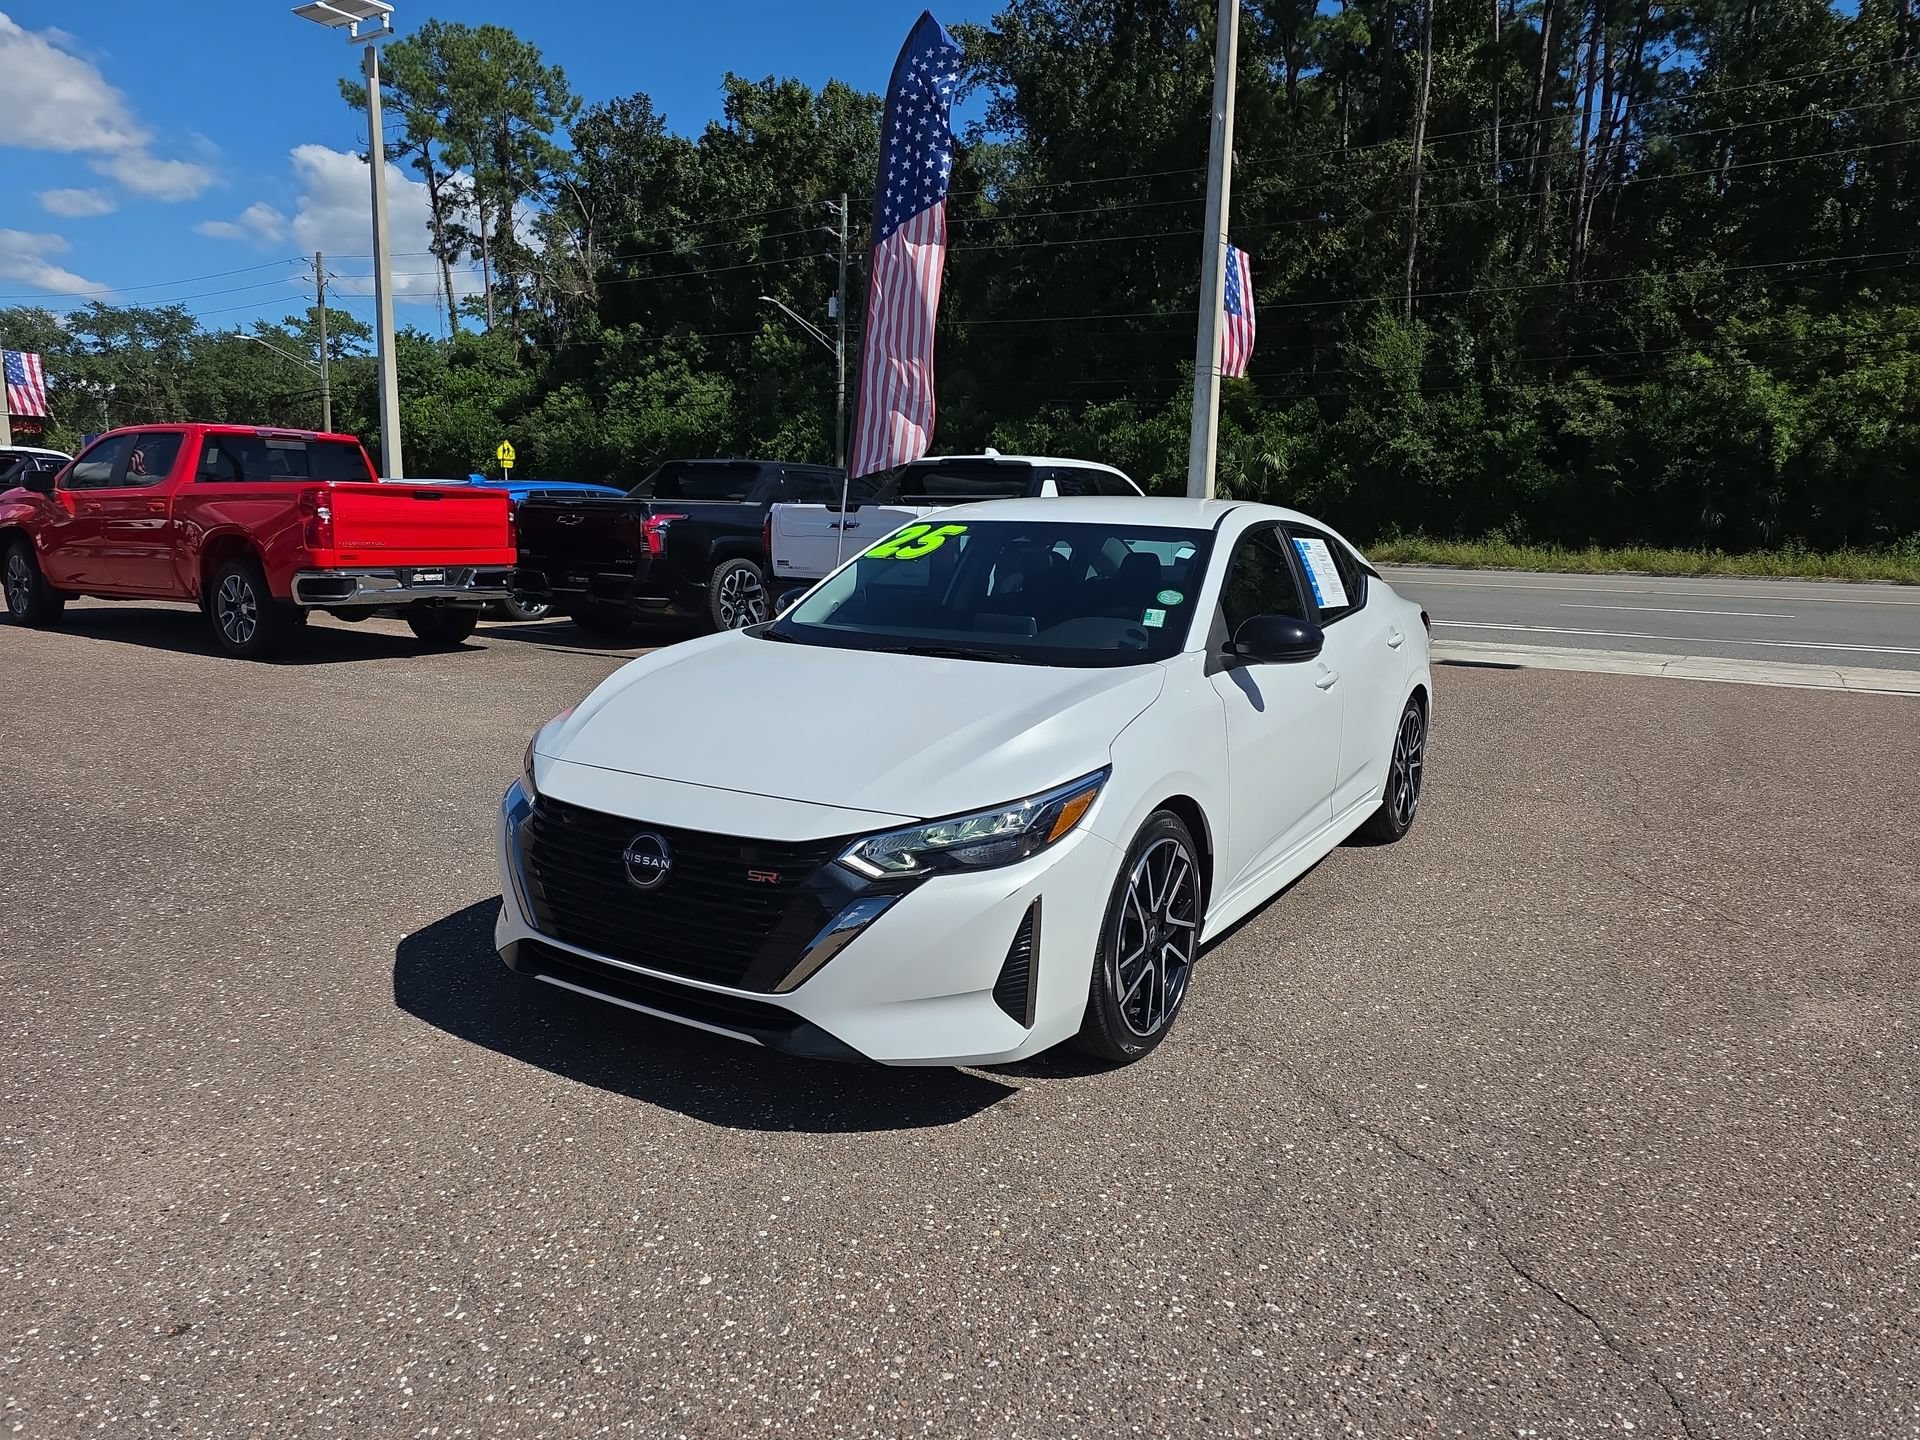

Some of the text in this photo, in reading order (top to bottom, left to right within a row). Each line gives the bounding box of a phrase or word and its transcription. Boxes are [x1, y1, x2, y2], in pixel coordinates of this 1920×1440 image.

[864, 525, 968, 560] 25
[623, 850, 670, 869] NISSAN
[747, 870, 777, 884] SR
